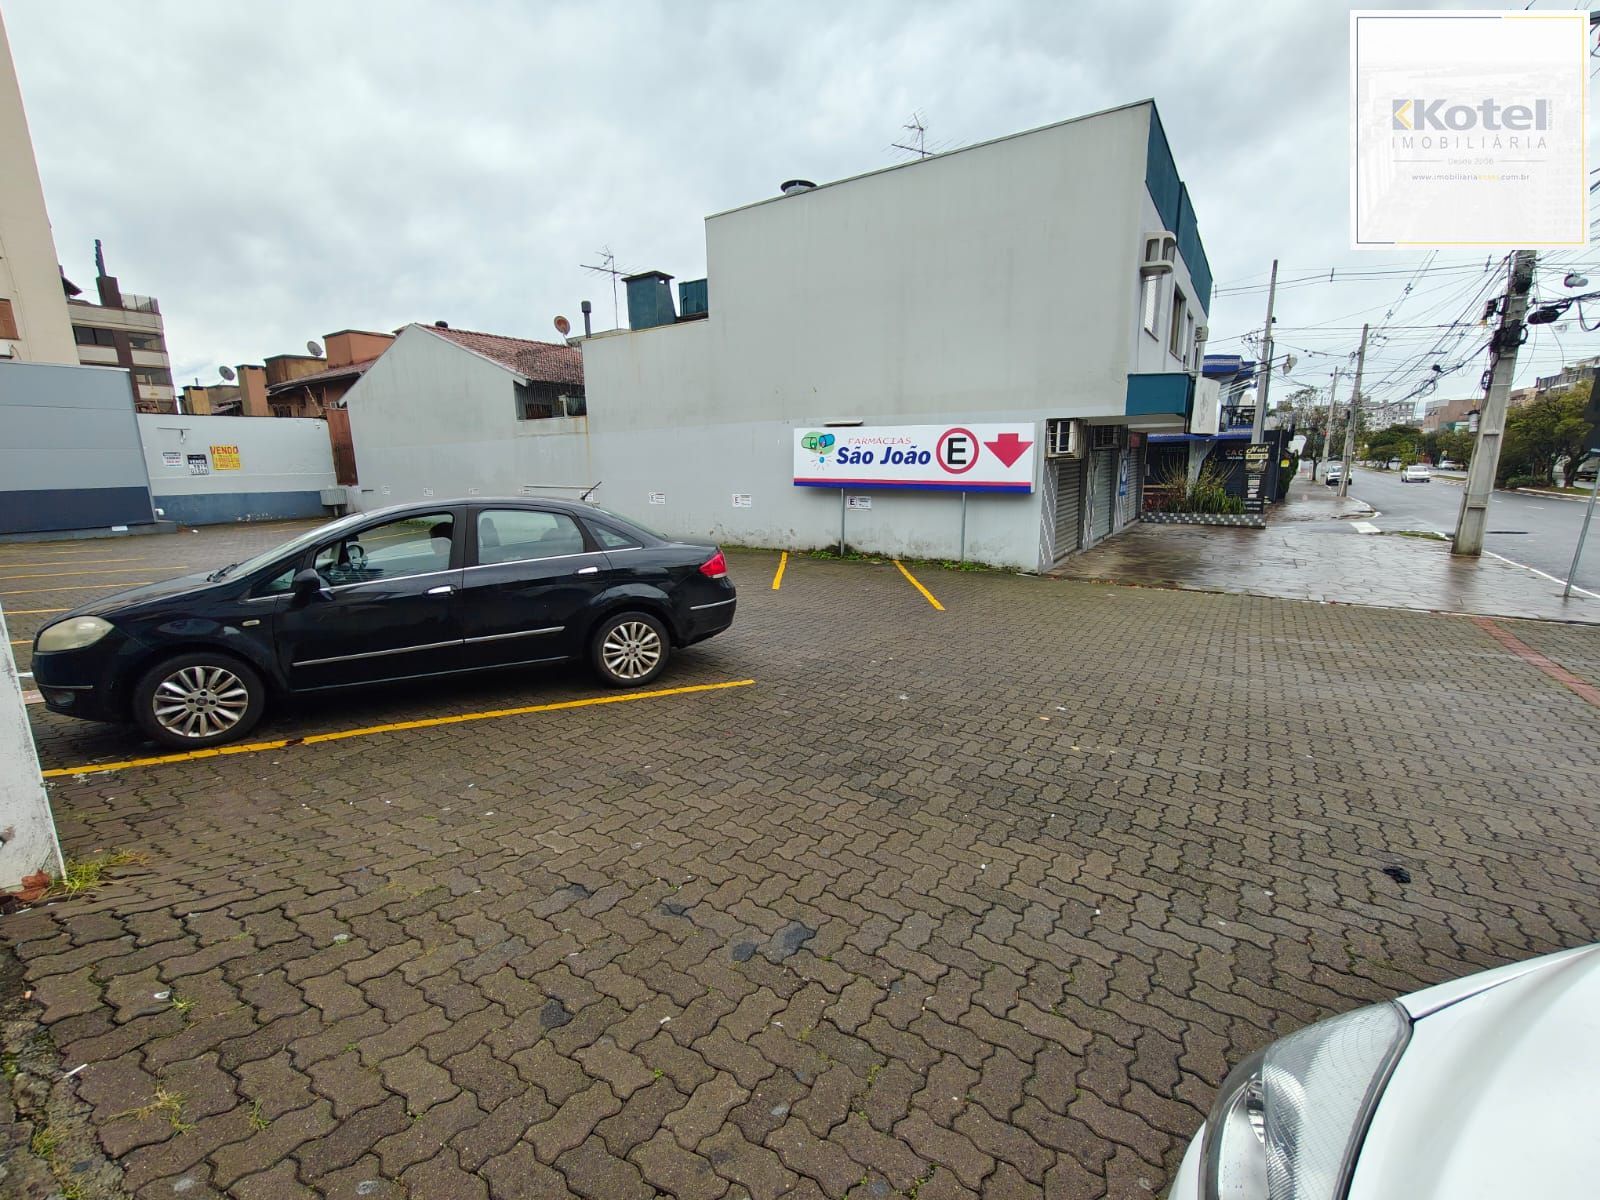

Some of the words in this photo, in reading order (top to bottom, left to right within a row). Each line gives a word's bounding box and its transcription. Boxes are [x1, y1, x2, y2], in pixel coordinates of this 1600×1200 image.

[210, 446, 239, 454] VENDO
[836, 445, 874, 464] São
[880, 445, 931, 464] João
[947, 437, 967, 464] E
